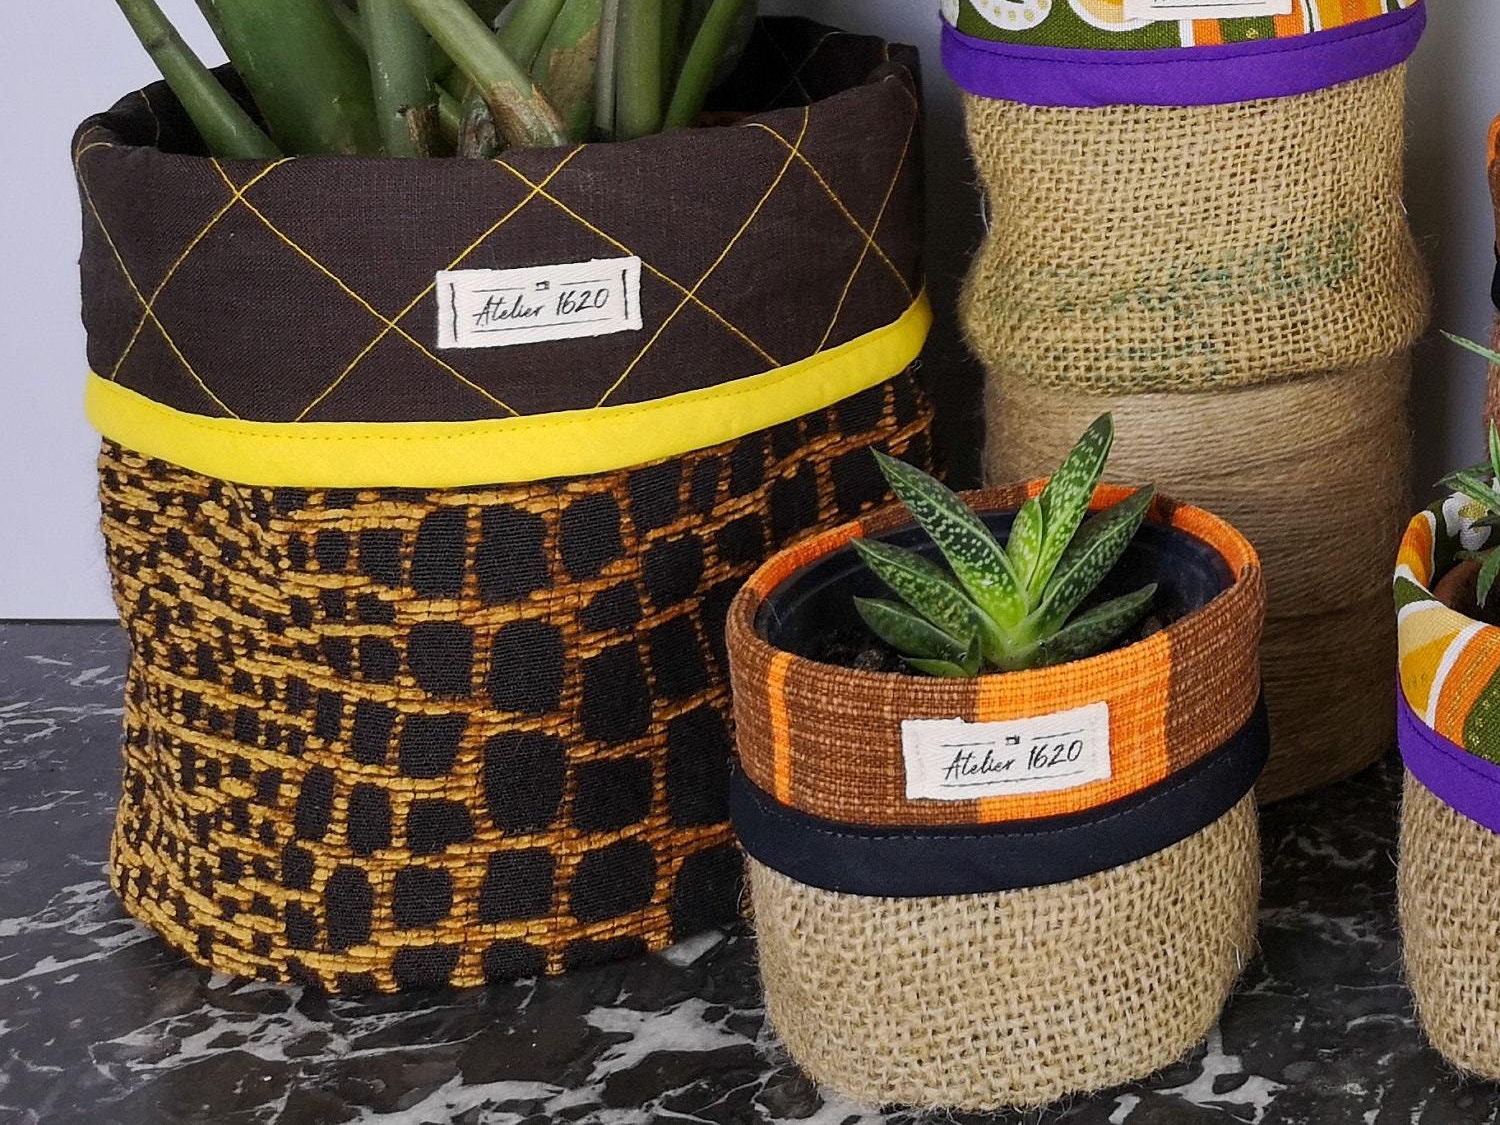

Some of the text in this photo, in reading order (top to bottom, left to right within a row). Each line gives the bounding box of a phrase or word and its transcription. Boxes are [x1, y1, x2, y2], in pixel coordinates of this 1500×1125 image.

[472, 288, 609, 326] Atelier 1620
[942, 739, 1084, 781] Atelier 1620
